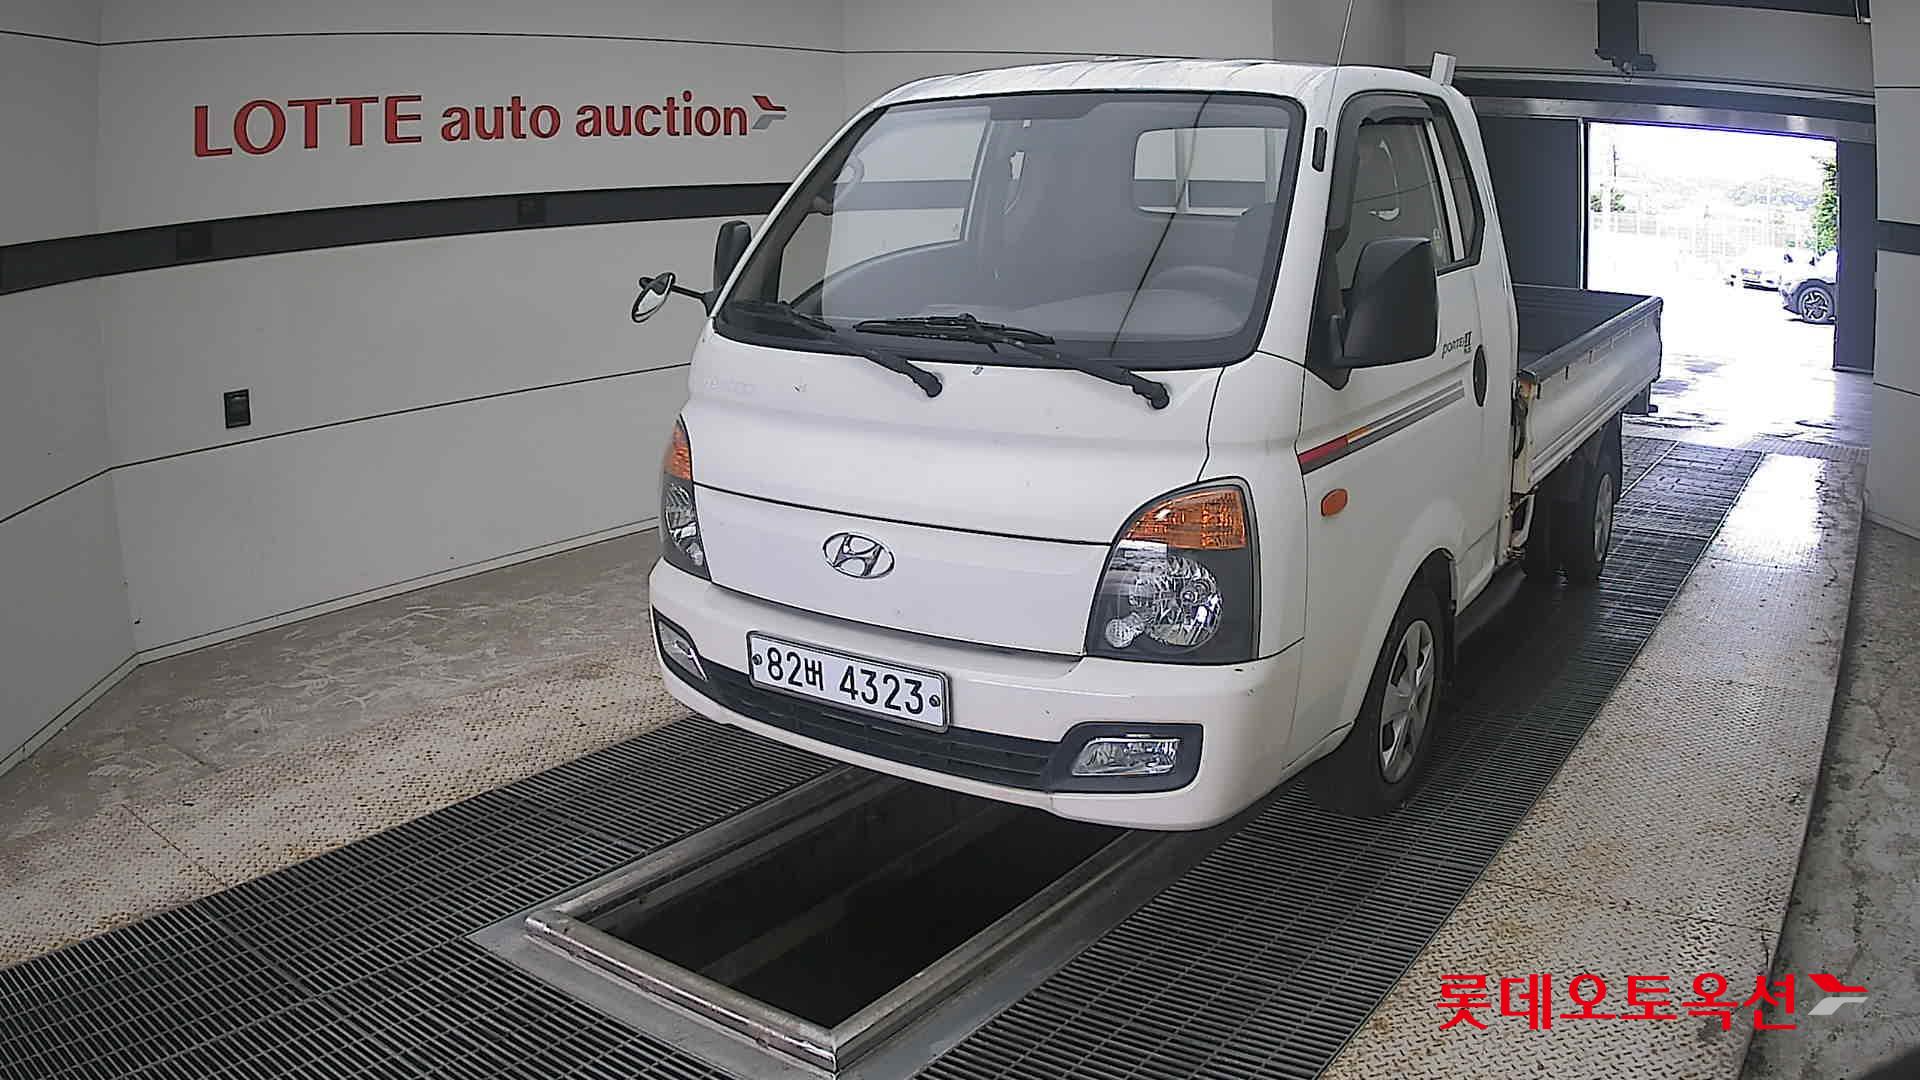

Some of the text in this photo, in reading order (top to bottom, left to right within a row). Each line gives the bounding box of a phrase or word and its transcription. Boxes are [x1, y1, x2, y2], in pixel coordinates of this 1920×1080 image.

[193, 90, 749, 158] LOTTE auto auction
[767, 646, 924, 715] 82버 4323
